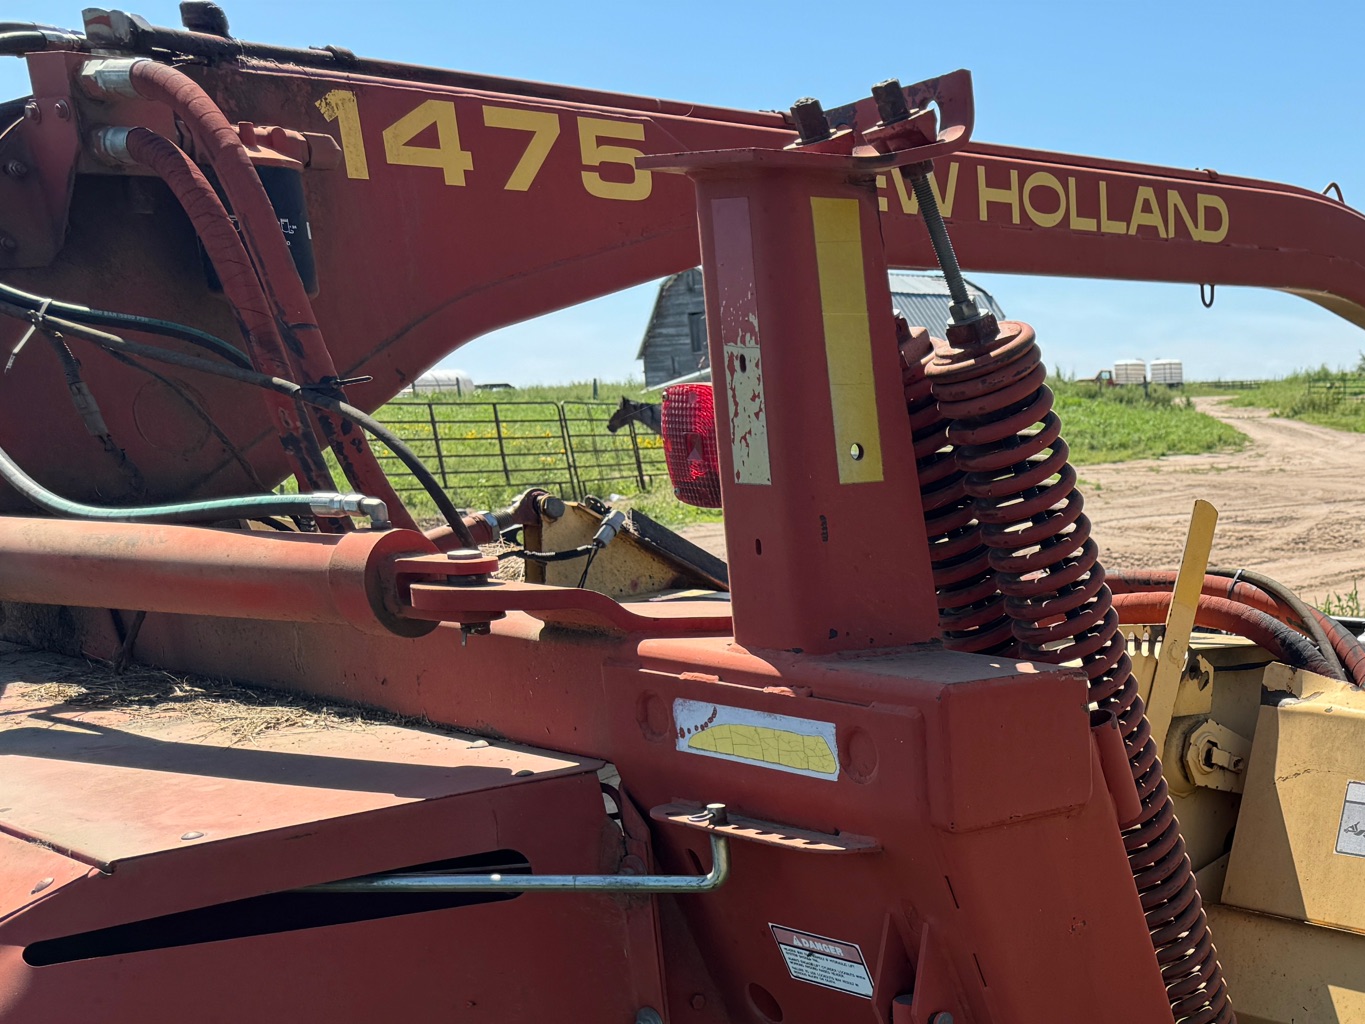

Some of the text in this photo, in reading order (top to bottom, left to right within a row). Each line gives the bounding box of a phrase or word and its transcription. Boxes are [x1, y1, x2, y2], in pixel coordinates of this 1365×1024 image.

[314, 89, 653, 201] 1475
[977, 165, 1229, 243] HOLLAND
[800, 938, 844, 957] DANGER
